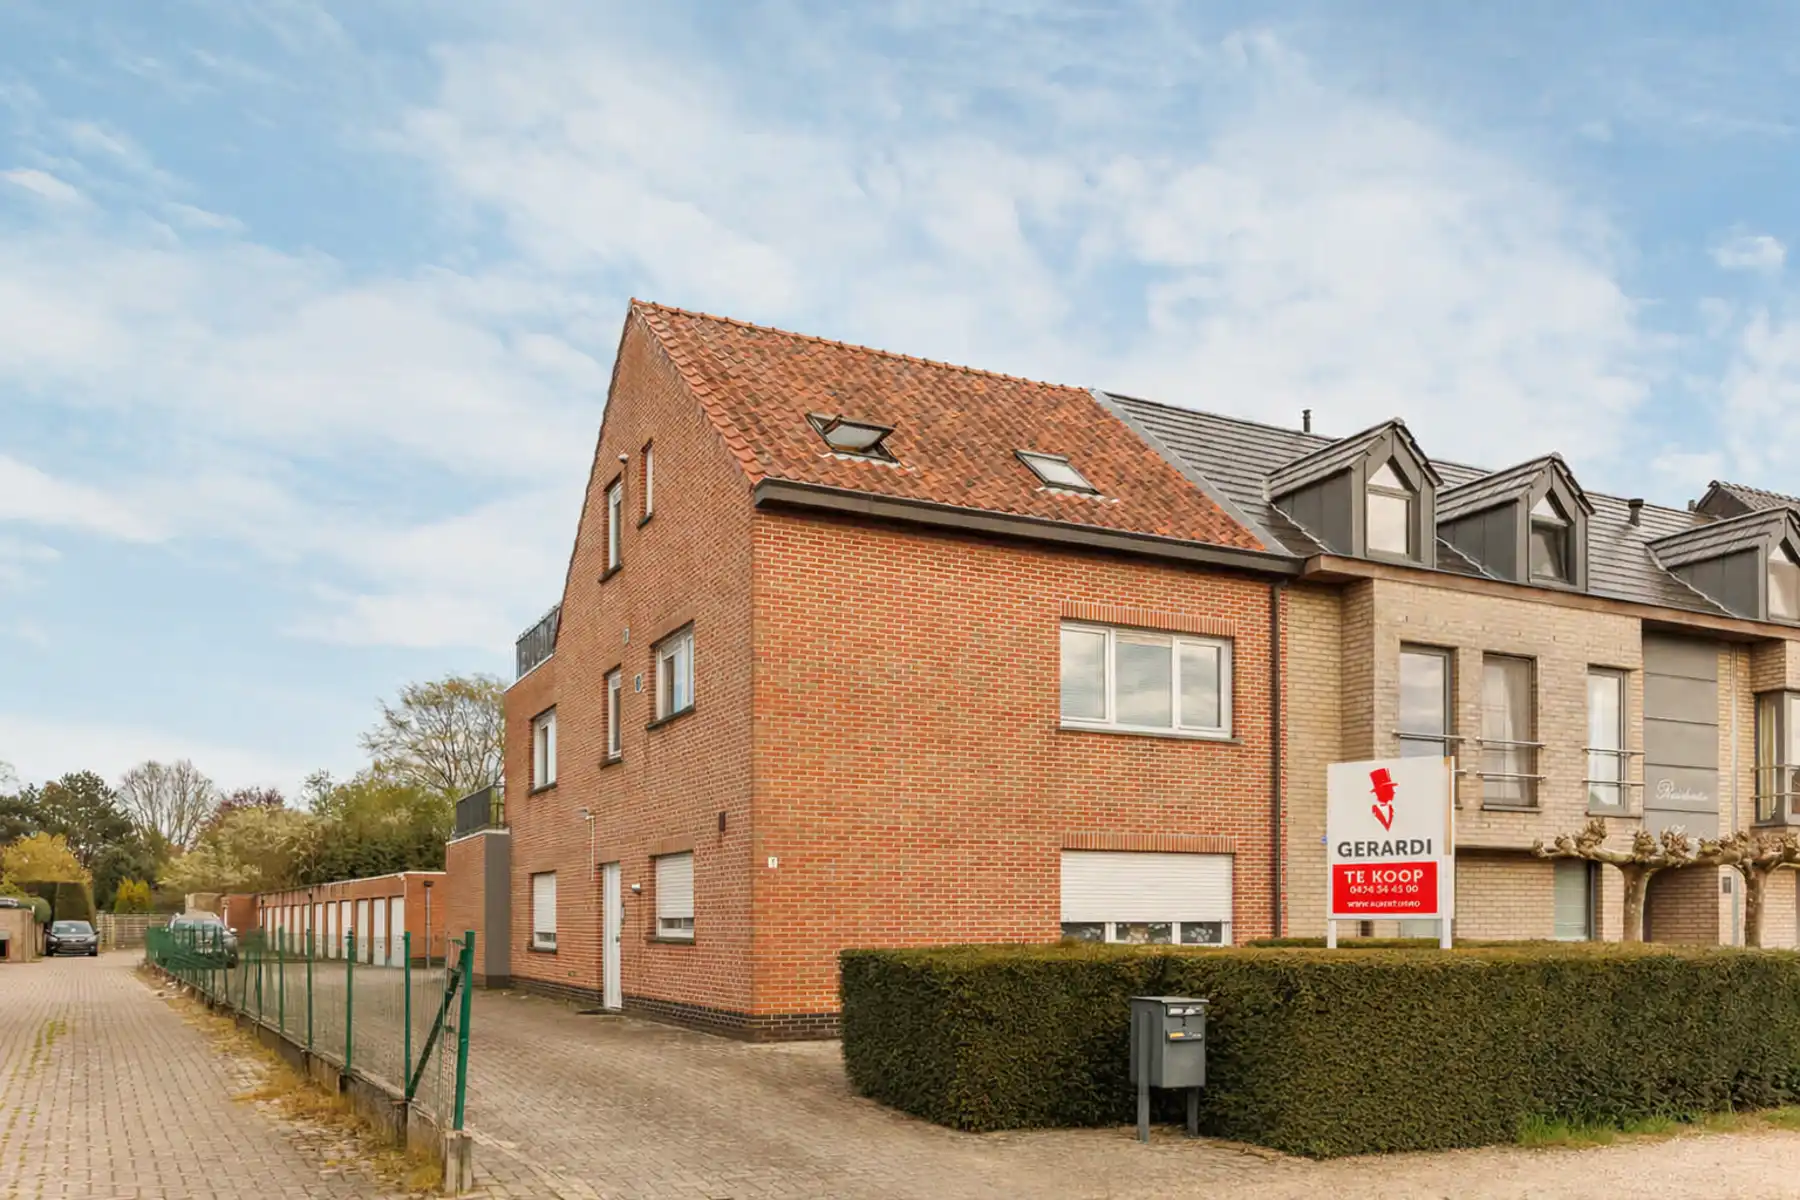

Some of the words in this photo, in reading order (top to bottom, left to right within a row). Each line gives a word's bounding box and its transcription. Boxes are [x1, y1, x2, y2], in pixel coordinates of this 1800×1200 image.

[1338, 838, 1432, 857] GERARDI
[1344, 869, 1365, 884] TE
[1372, 869, 1424, 883] KOOP
[1405, 884, 1419, 893] 00
